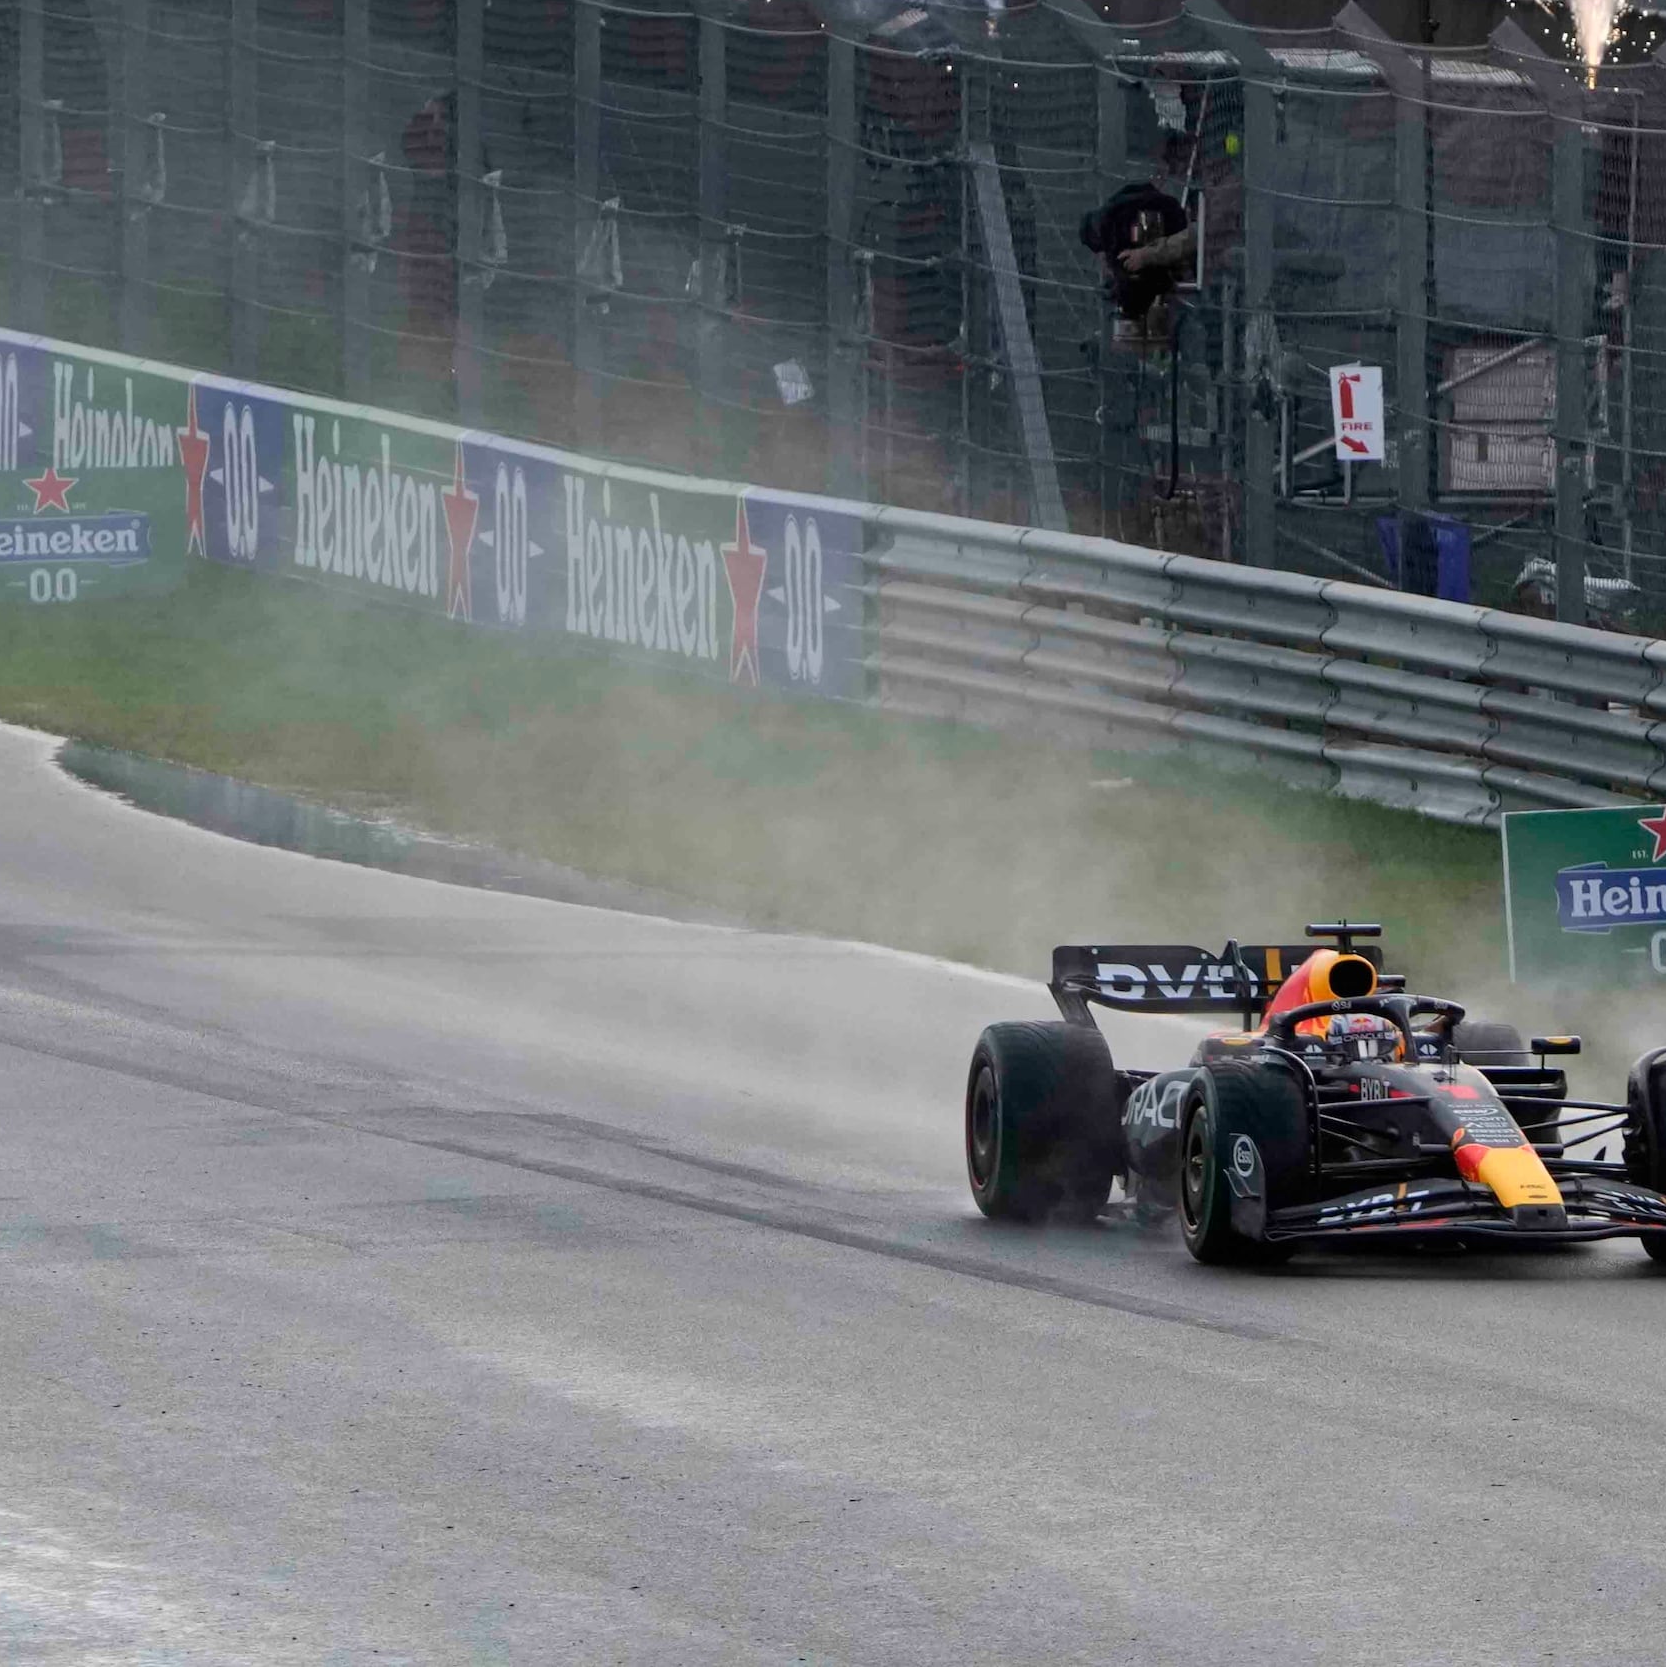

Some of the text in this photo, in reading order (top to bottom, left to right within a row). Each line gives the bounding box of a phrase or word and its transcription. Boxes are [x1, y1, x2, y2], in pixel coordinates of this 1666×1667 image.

[1341, 421, 1373, 431] FIRE
[292, 414, 439, 598] Heineken
[29, 567, 78, 603] 0.0
[564, 474, 720, 661] Heineken
[1343, 1032, 1384, 1043] ORACLE
